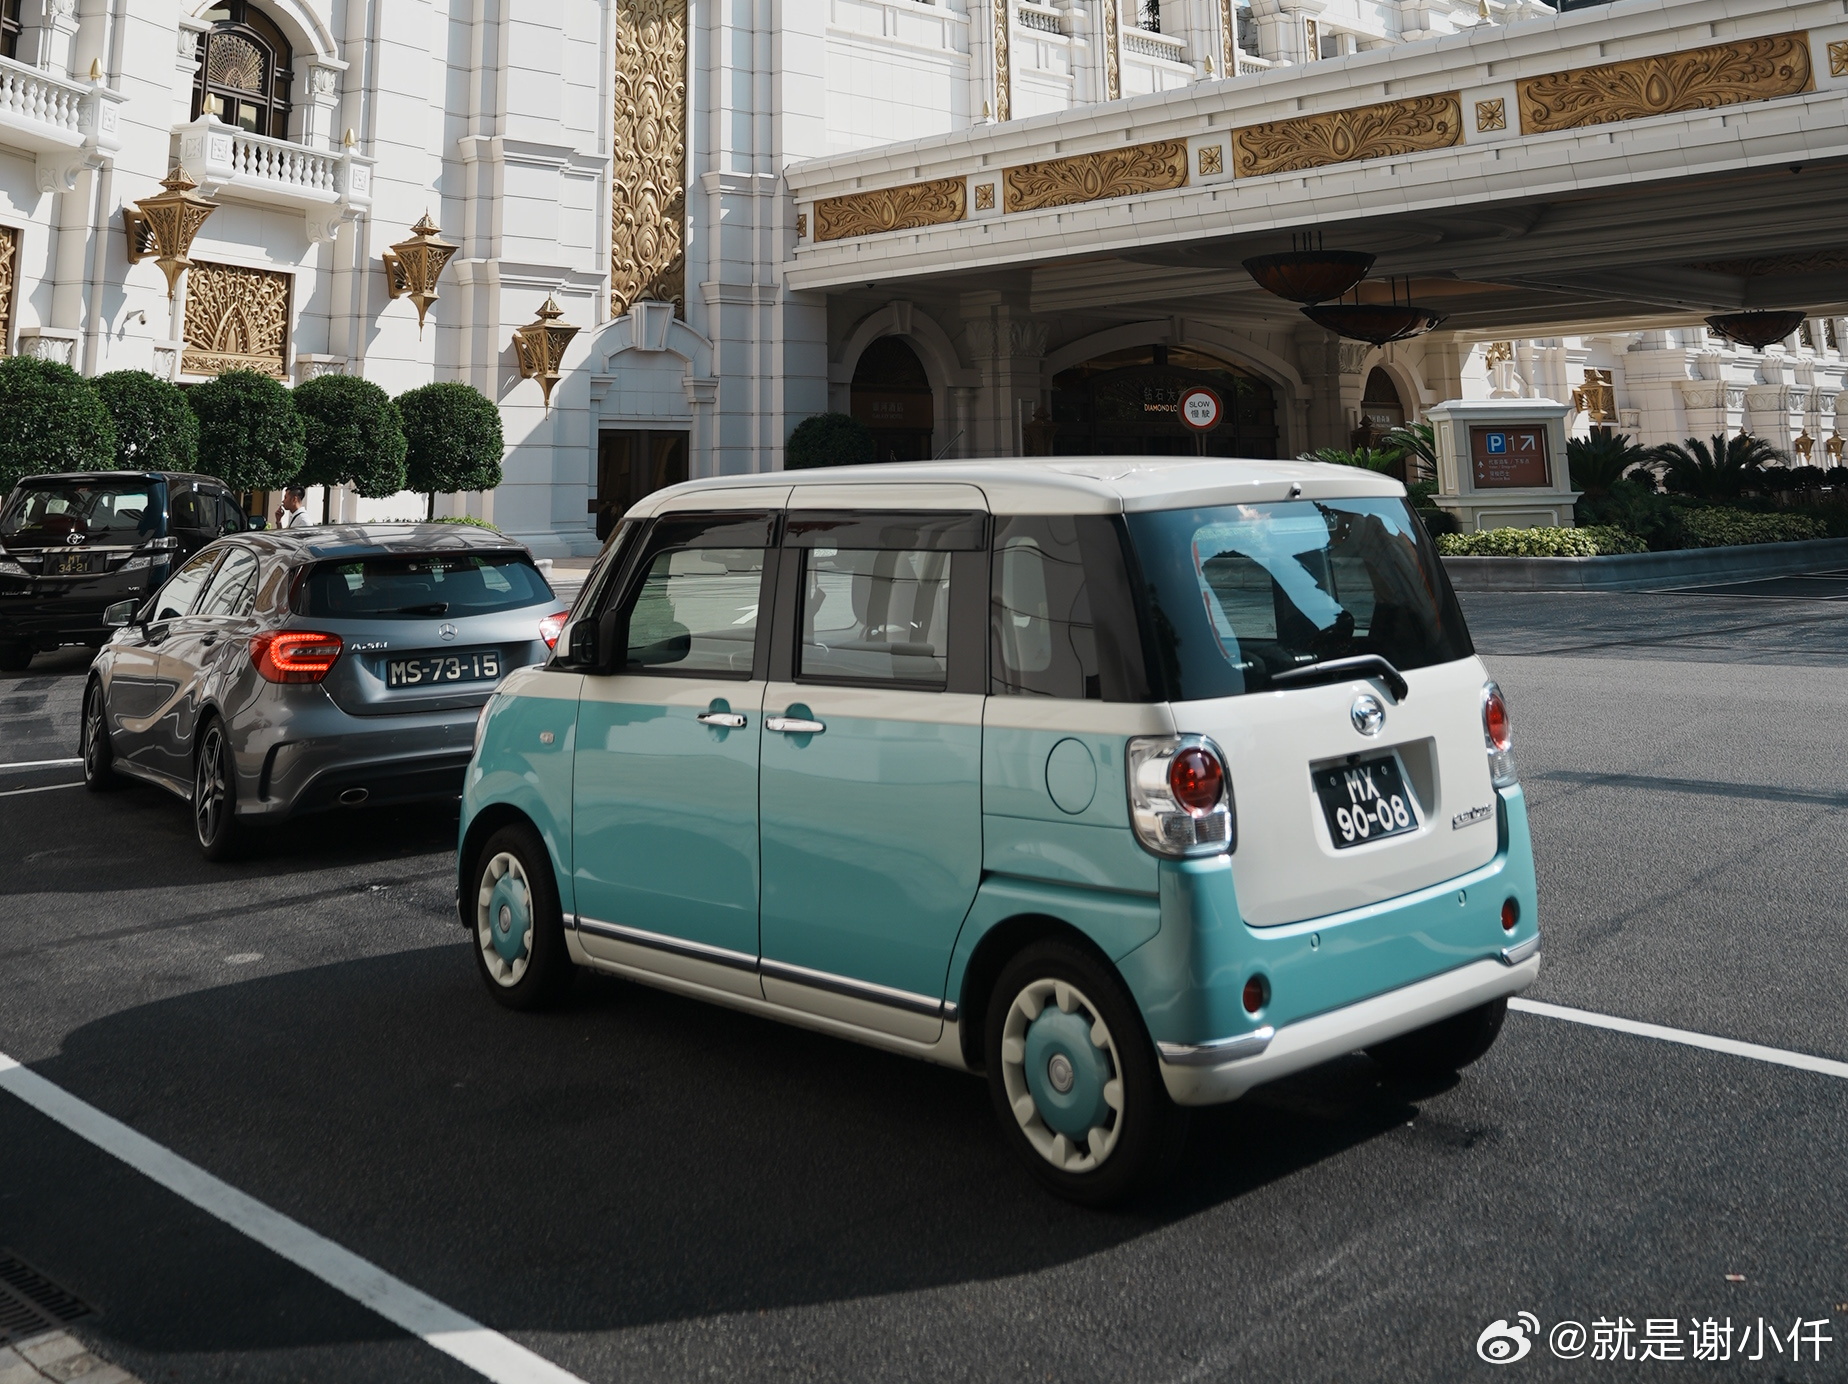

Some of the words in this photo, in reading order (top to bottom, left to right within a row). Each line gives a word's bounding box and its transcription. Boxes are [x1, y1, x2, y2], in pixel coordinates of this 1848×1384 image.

[1144, 387, 1181, 401] 钻石大
[1144, 403, 1170, 413] DIAMOND
[1191, 410, 1210, 418] 慢駛
[1490, 435, 1502, 452] P
[1508, 435, 1515, 452] 1
[68, 554, 81, 564] MT
[59, 562, 88, 573] 34-21
[390, 654, 499, 685] MS-73-15
[1343, 766, 1381, 804] MX
[1336, 794, 1410, 842] 90-08
